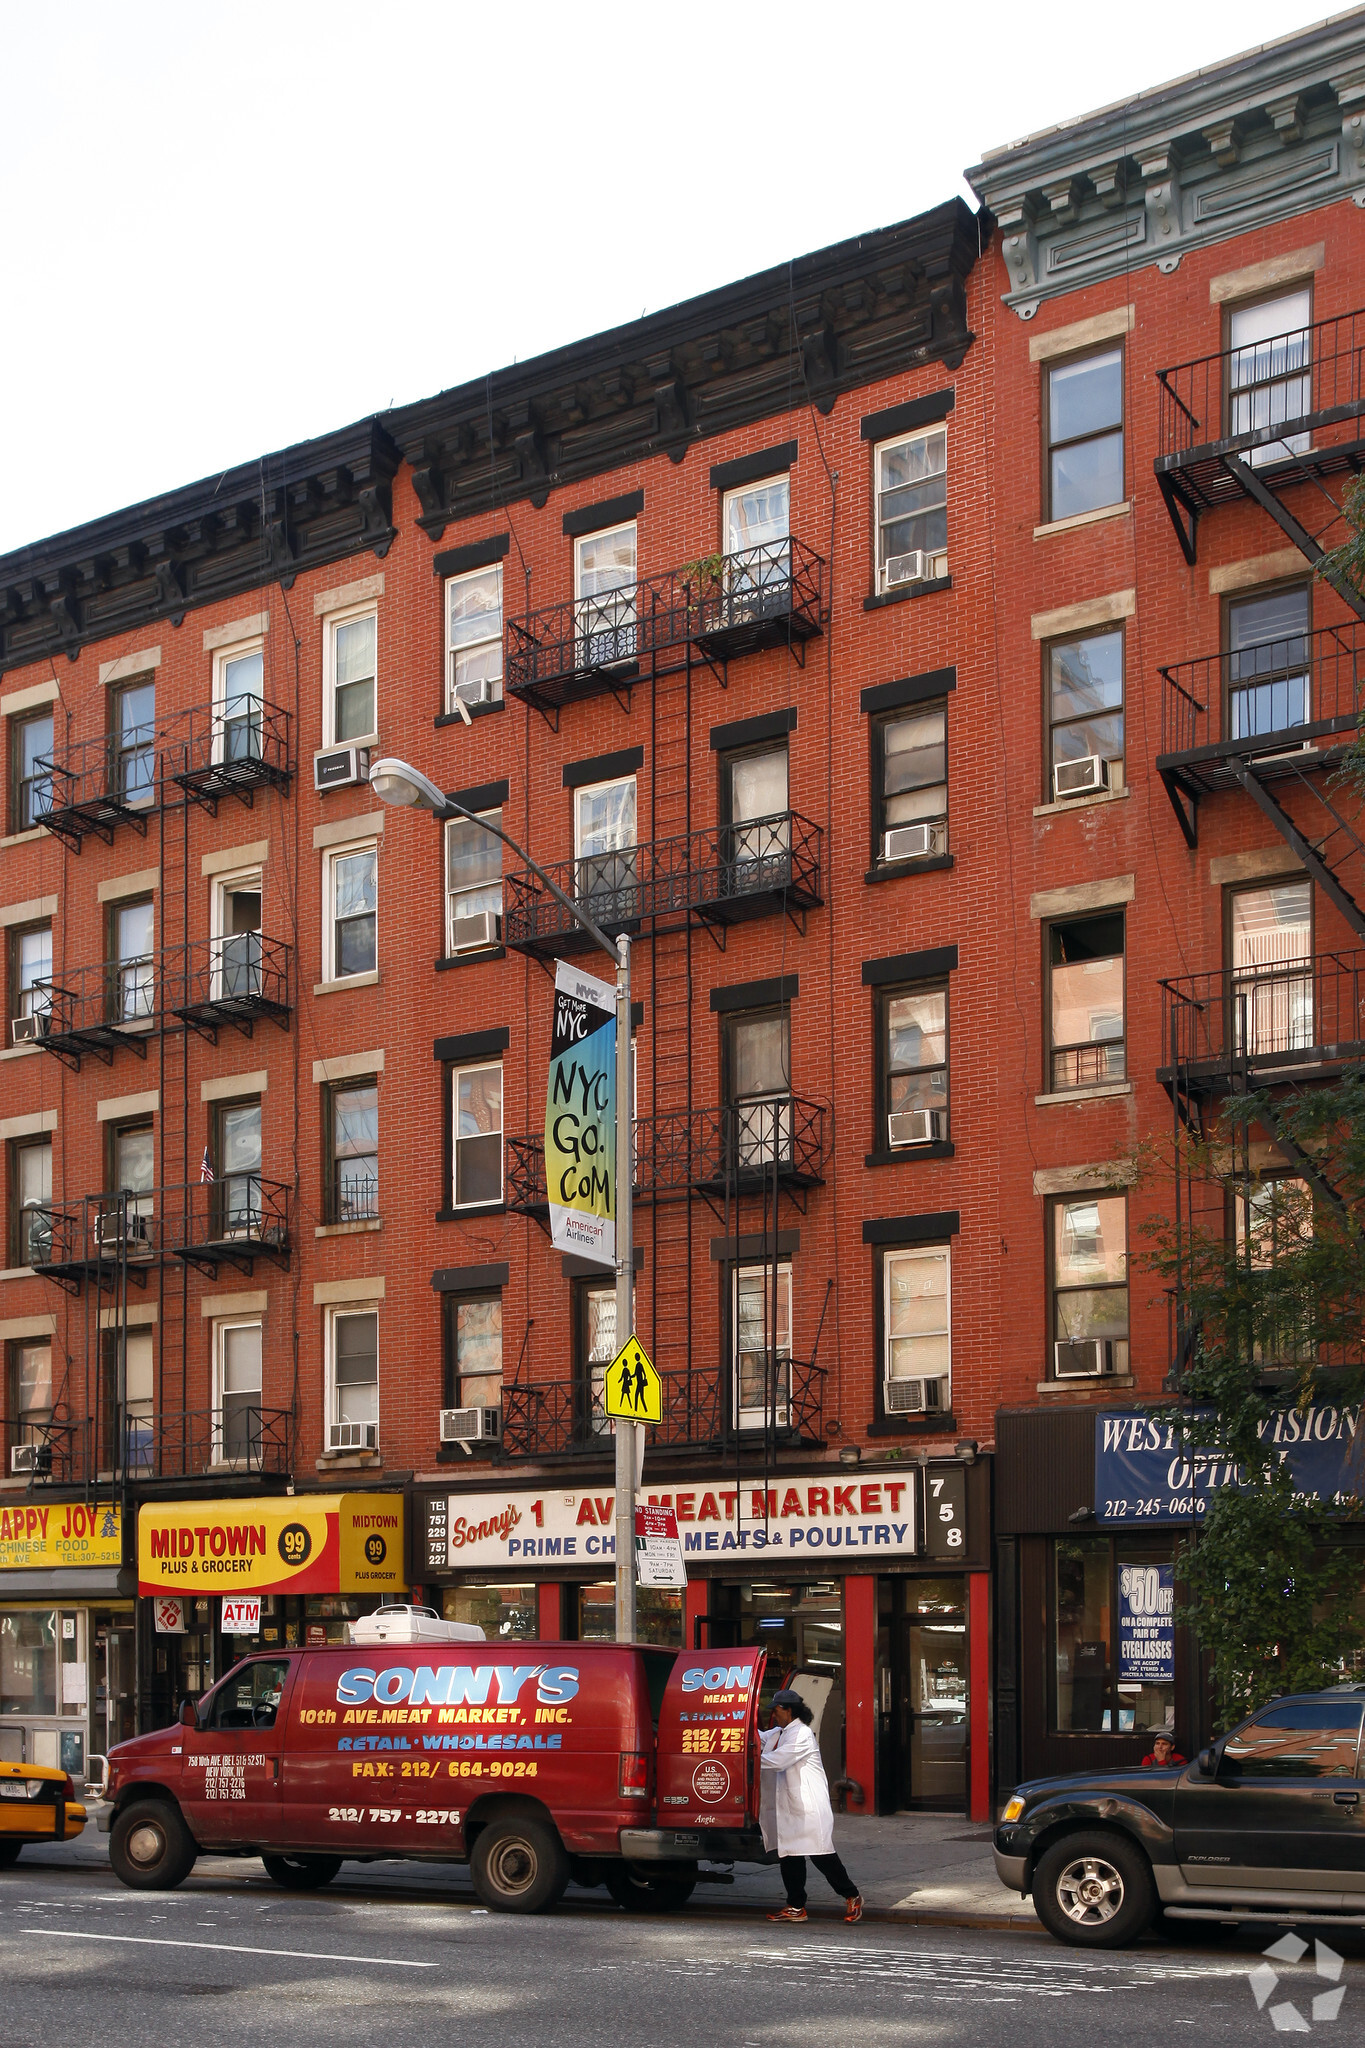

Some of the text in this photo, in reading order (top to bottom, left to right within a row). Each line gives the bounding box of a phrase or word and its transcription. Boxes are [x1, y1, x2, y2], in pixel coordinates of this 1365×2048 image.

[575, 983, 599, 1002] NYC
[558, 996, 571, 1009] GET
[557, 1009, 587, 1041] NYC
[553, 1061, 608, 1116] NYC
[566, 1217, 603, 1236] American
[566, 1228, 595, 1245] Airlines
[452, 1504, 522, 1549] Sonny's
[576, 1497, 615, 1526] AV
[752, 1482, 907, 1519] MARKET
[645, 1507, 673, 1516] STANDING
[0, 1505, 98, 1540] APPY JOY
[352, 1515, 398, 1528] MIDTOWN
[0, 1540, 89, 1554] CHINESE FOOD
[151, 1525, 266, 1558] MIDTOWN
[284, 1531, 305, 1553] 99
[369, 1540, 383, 1556] 99
[508, 1536, 577, 1557] PRIME
[685, 1529, 767, 1551] MEATS
[773, 1532, 783, 1545] &
[789, 1523, 909, 1548] POULTRY
[14, 1554, 30, 1563] AVE
[161, 1559, 253, 1574] PLUS & GROCERY
[371, 1571, 396, 1580] GROCERY
[1121, 1567, 1173, 1615] $50 OFF
[168, 1600, 182, 1616] ATM
[223, 1604, 259, 1621] ATM
[1136, 1617, 1172, 1627] COMPLETE
[1133, 1629, 1159, 1638] PAIR OF
[1122, 1641, 1172, 1659] EYEGLASSES
[336, 1664, 580, 1705] SONNY'S
[703, 1694, 735, 1704] MEAT
[300, 1709, 337, 1724] 10th
[437, 1708, 527, 1726] MARKET,
[534, 1708, 573, 1723] INC.
[682, 1728, 718, 1741] 212/
[682, 1741, 717, 1753] 212/
[188, 1756, 199, 1767] 758
[247, 1755, 255, 1766] 52
[205, 1766, 245, 1778] NEW YORK, NY
[352, 1761, 538, 1779] FAX: 212/ 664-9024
[328, 1808, 365, 1824] 212/
[415, 1810, 460, 1825] 2276
[695, 1815, 716, 1825] Angie
